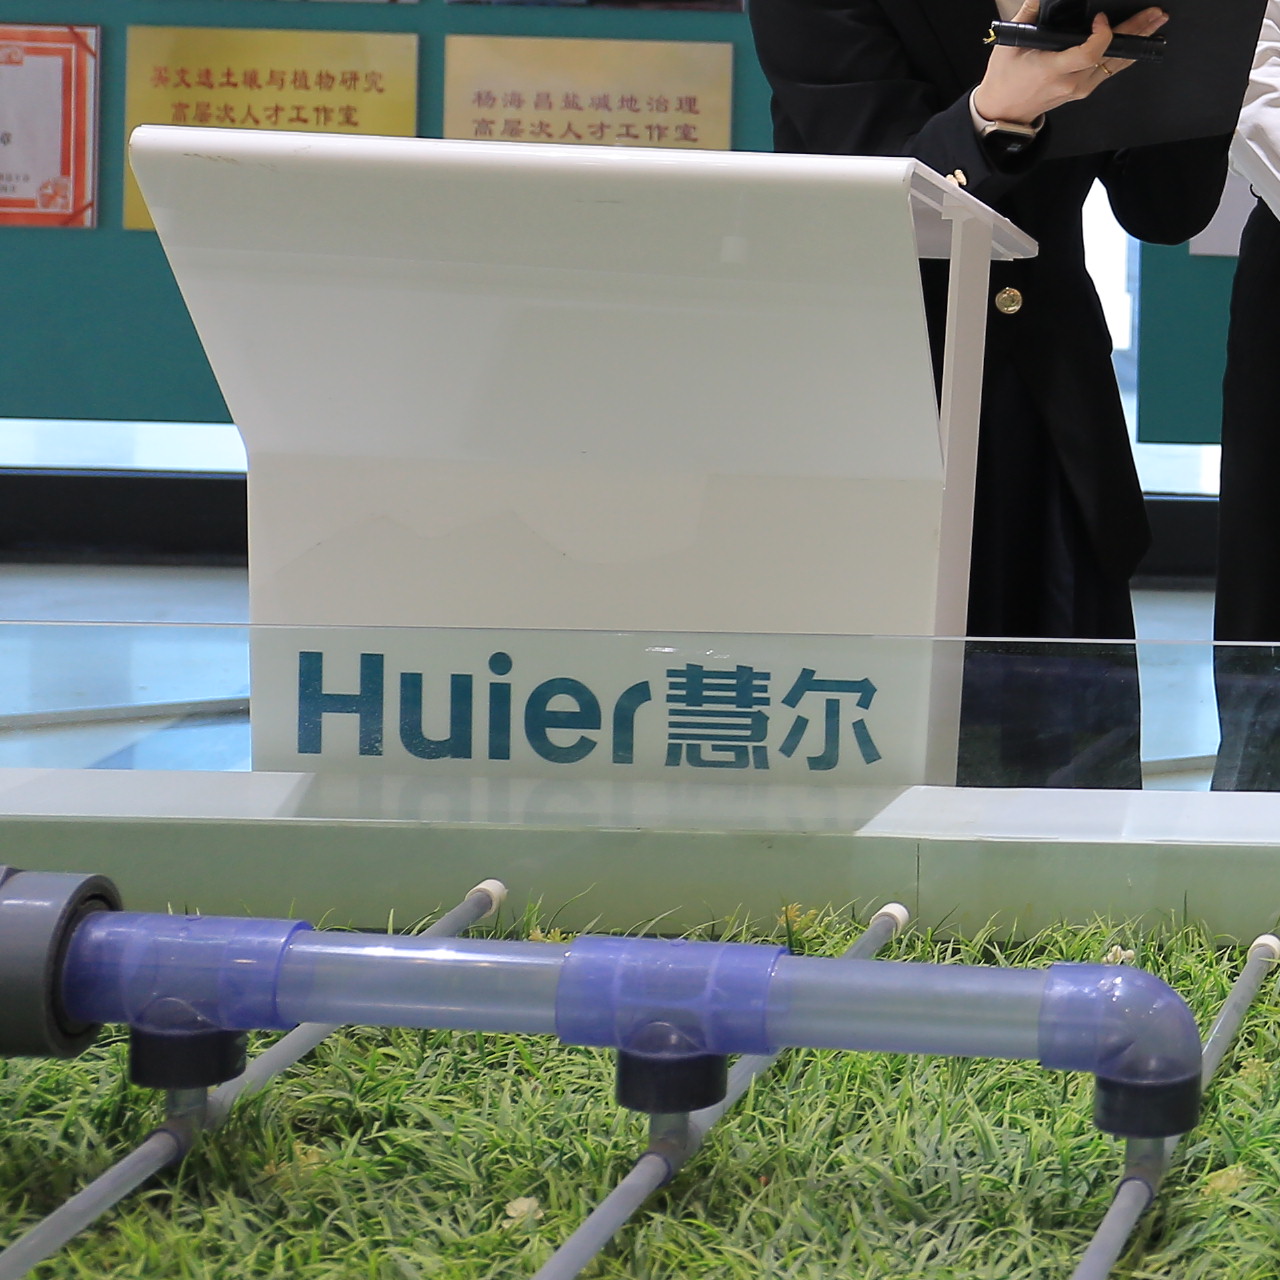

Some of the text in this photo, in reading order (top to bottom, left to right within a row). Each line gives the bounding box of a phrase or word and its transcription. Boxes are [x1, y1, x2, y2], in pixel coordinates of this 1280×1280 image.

[170, 101, 361, 128] 高层次人才工作室
[471, 89, 701, 116] 杨海昌盐碱地治理
[471, 118, 699, 143] 高层次人才工作室
